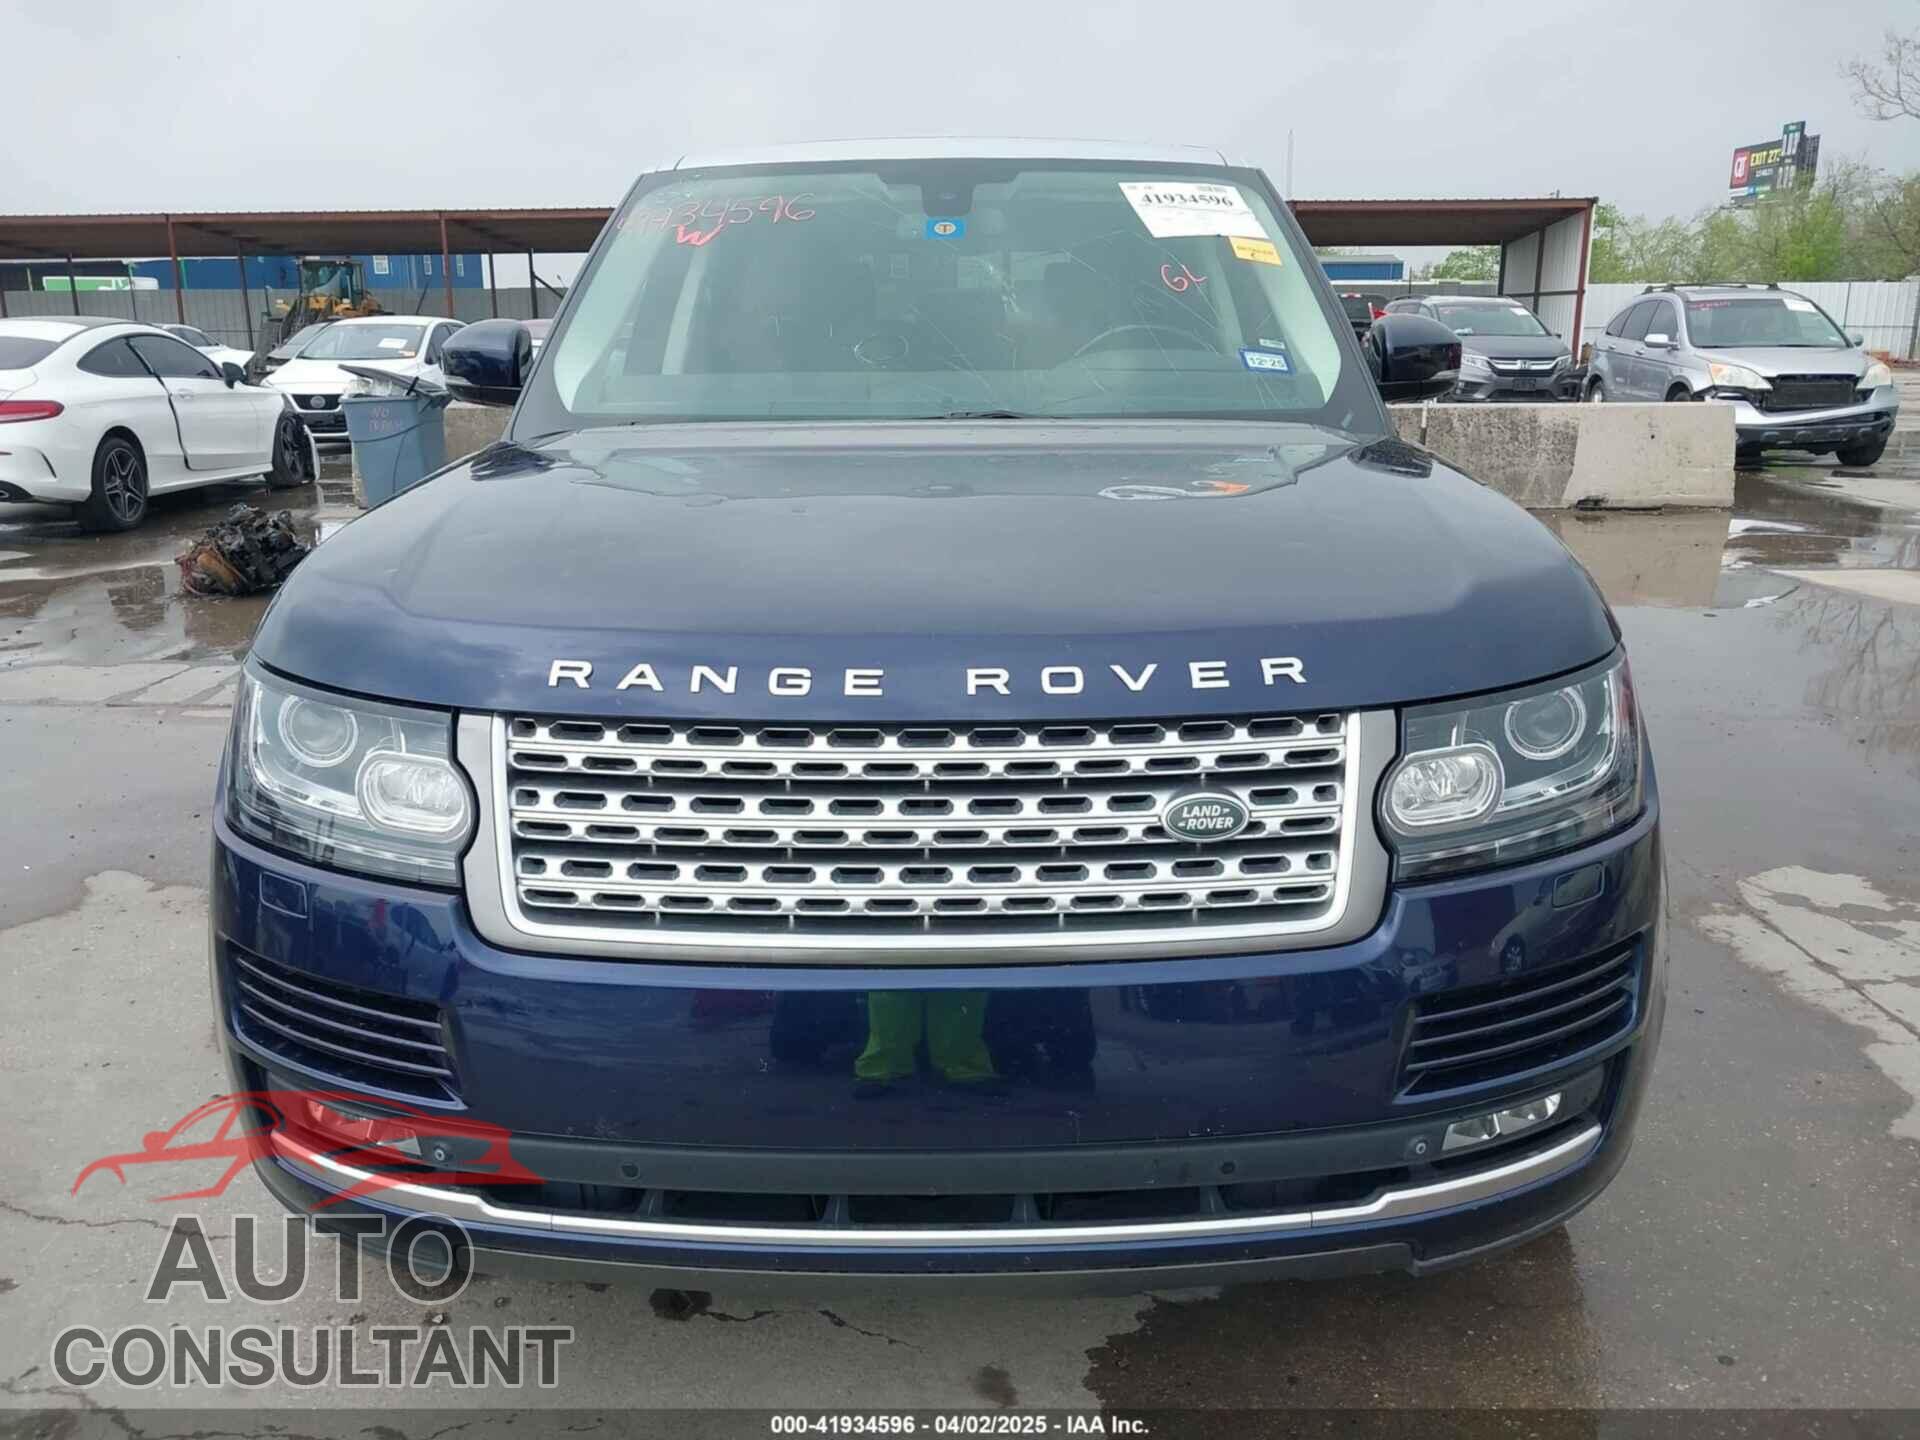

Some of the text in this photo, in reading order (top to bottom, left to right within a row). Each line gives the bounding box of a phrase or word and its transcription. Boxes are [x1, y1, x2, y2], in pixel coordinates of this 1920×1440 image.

[1141, 192, 1234, 208] 41934596
[548, 656, 1307, 697] RANGE ROVER
[1182, 805, 1221, 818] LAND
[1186, 816, 1235, 831] ROVER
